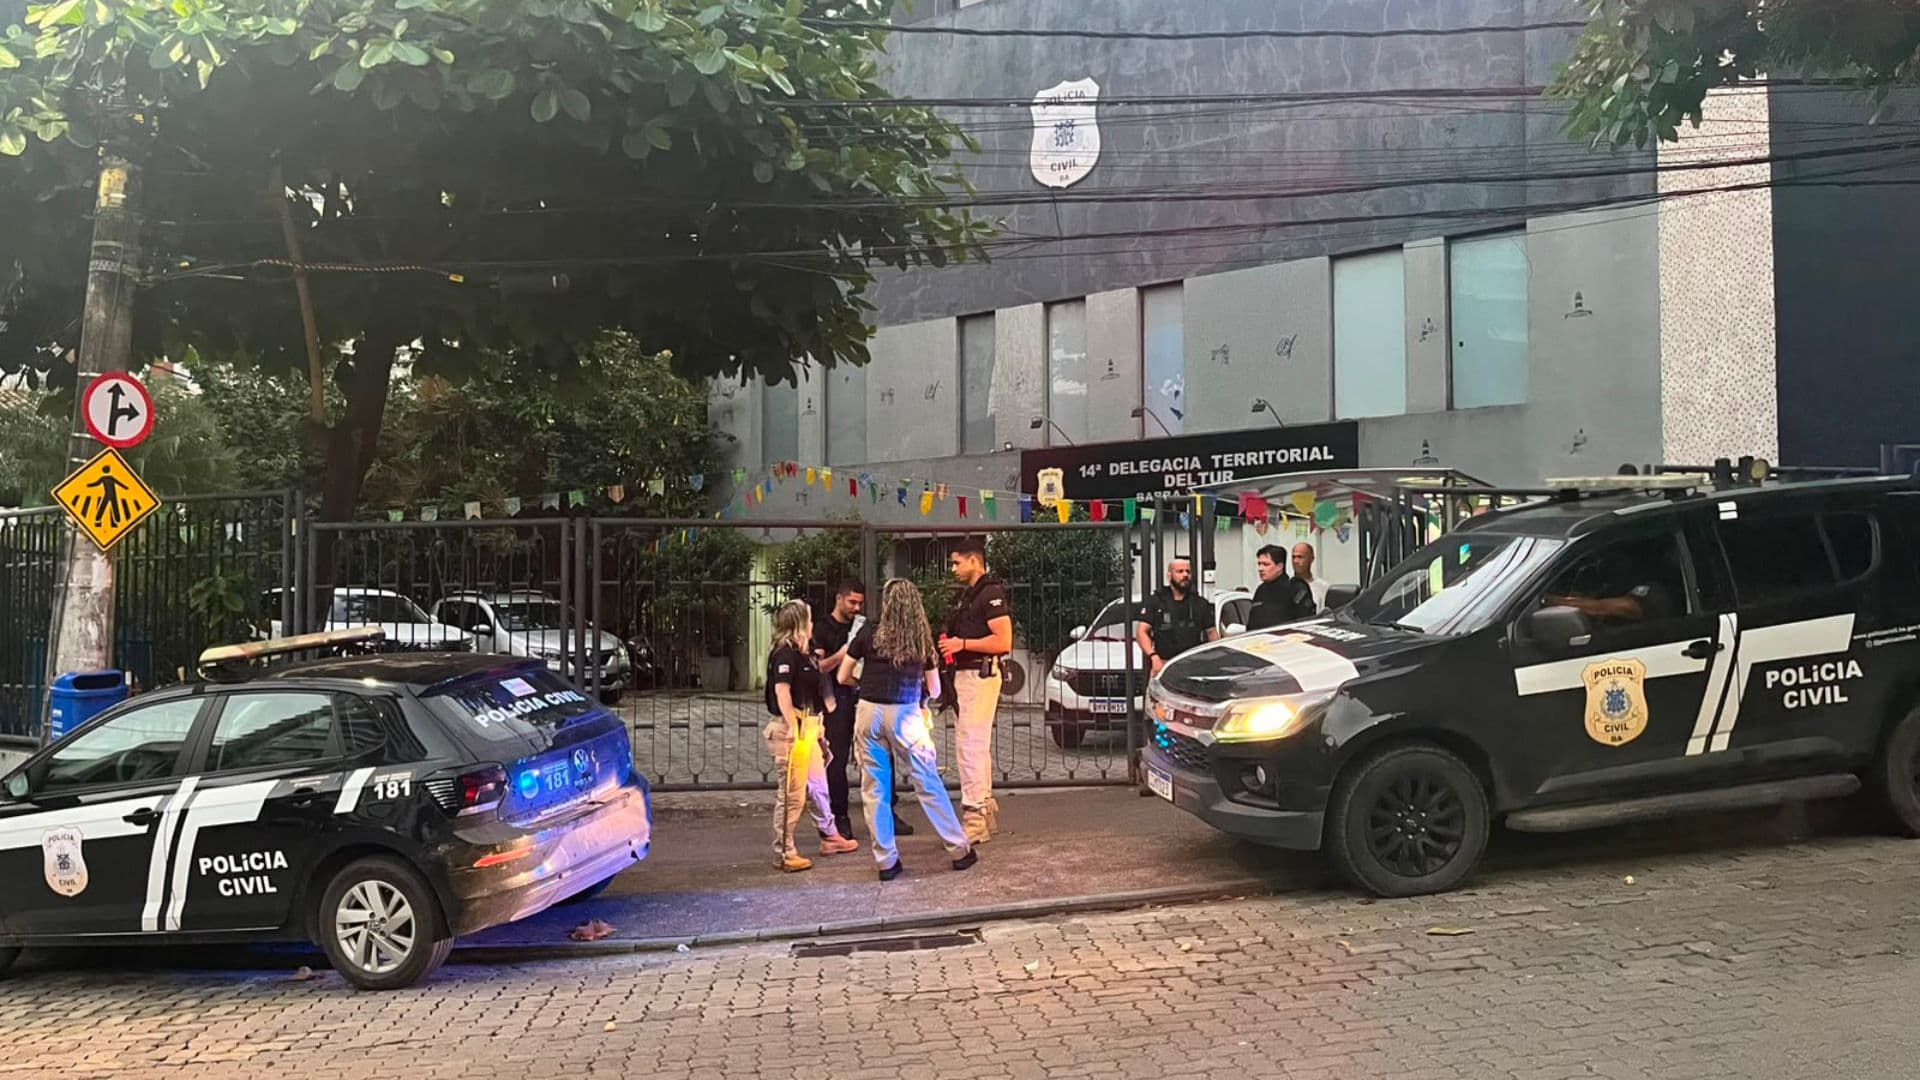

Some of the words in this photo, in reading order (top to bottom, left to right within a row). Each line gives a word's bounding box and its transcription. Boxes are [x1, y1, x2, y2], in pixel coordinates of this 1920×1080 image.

[1050, 158, 1078, 172] CIVIL
[1109, 456, 1201, 475] DELEGACIA
[1211, 446, 1334, 468] TERRITORIAL
[544, 690, 585, 705] CIVIL
[1783, 685, 1849, 708] CIVIL
[1604, 723, 1629, 733] CIVIL
[374, 779, 410, 800] 181
[545, 769, 570, 791] 181
[218, 875, 278, 897] CIVIL
